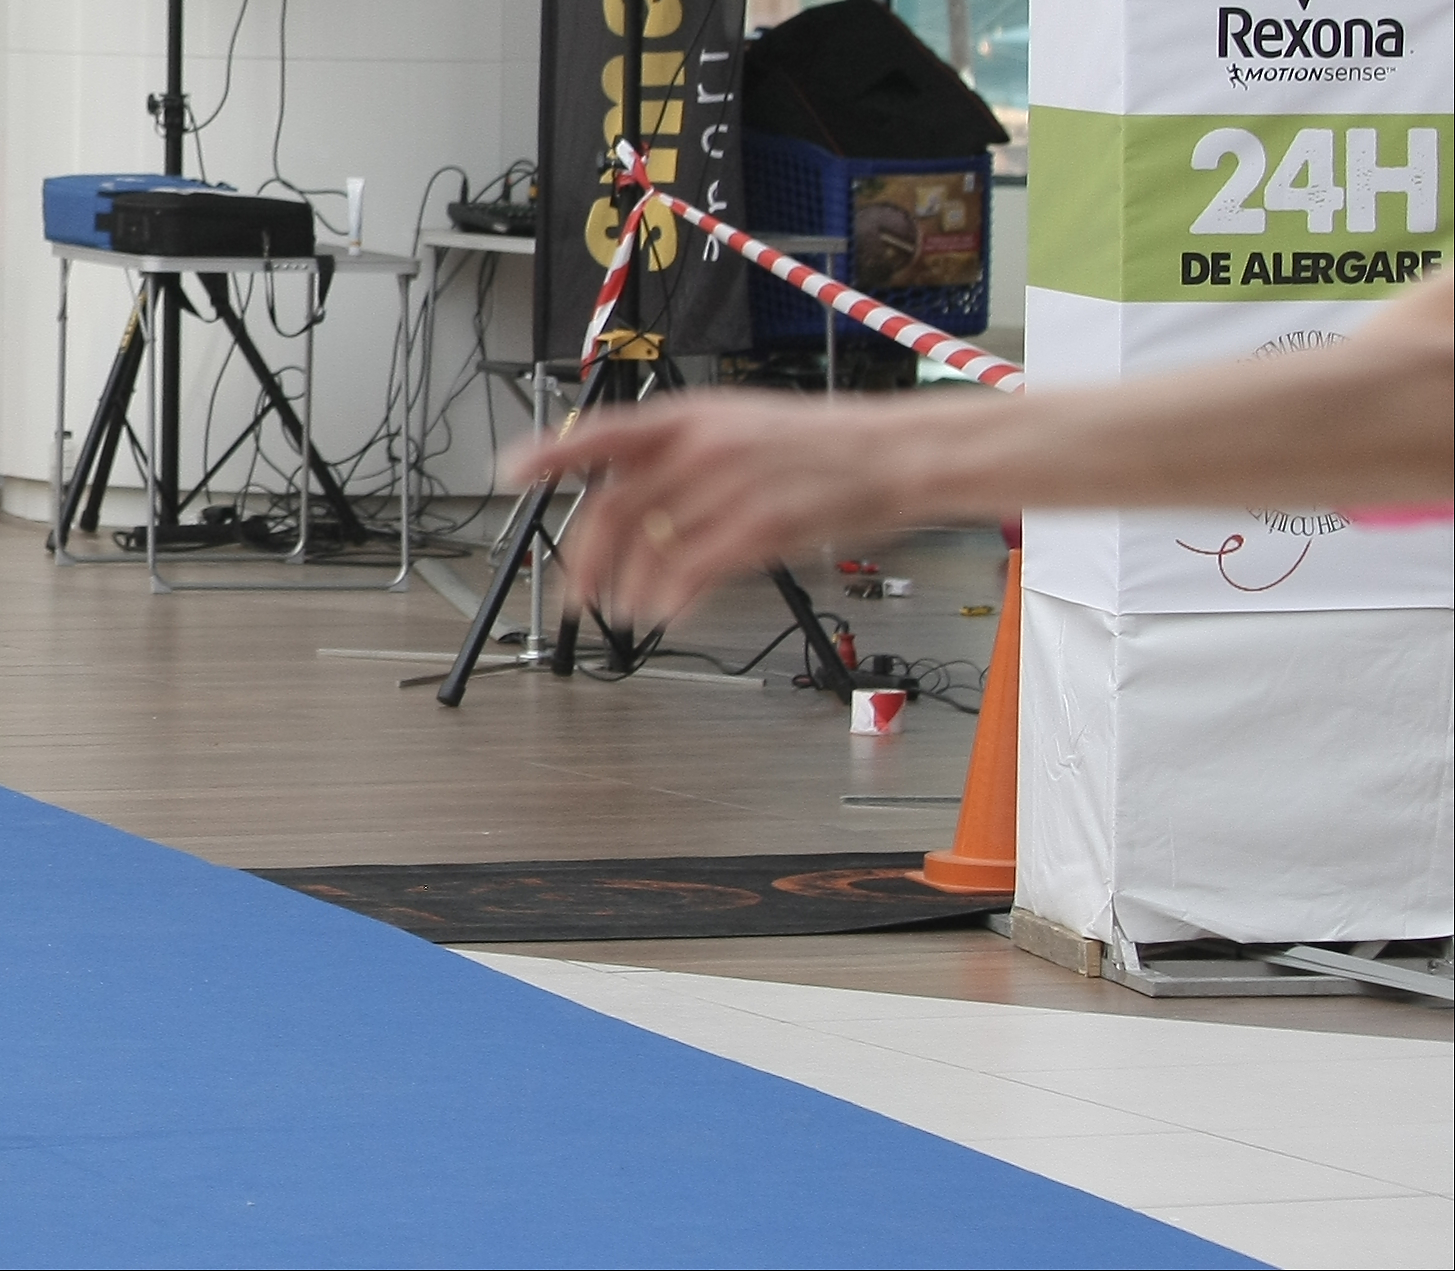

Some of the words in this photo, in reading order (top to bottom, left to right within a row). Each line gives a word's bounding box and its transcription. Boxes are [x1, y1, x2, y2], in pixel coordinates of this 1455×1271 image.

[1217, 7, 1406, 59] Rexona
[1189, 127, 1439, 234] 24H
[1181, 252, 1232, 285] DE
[1290, 515, 1315, 537] CU
